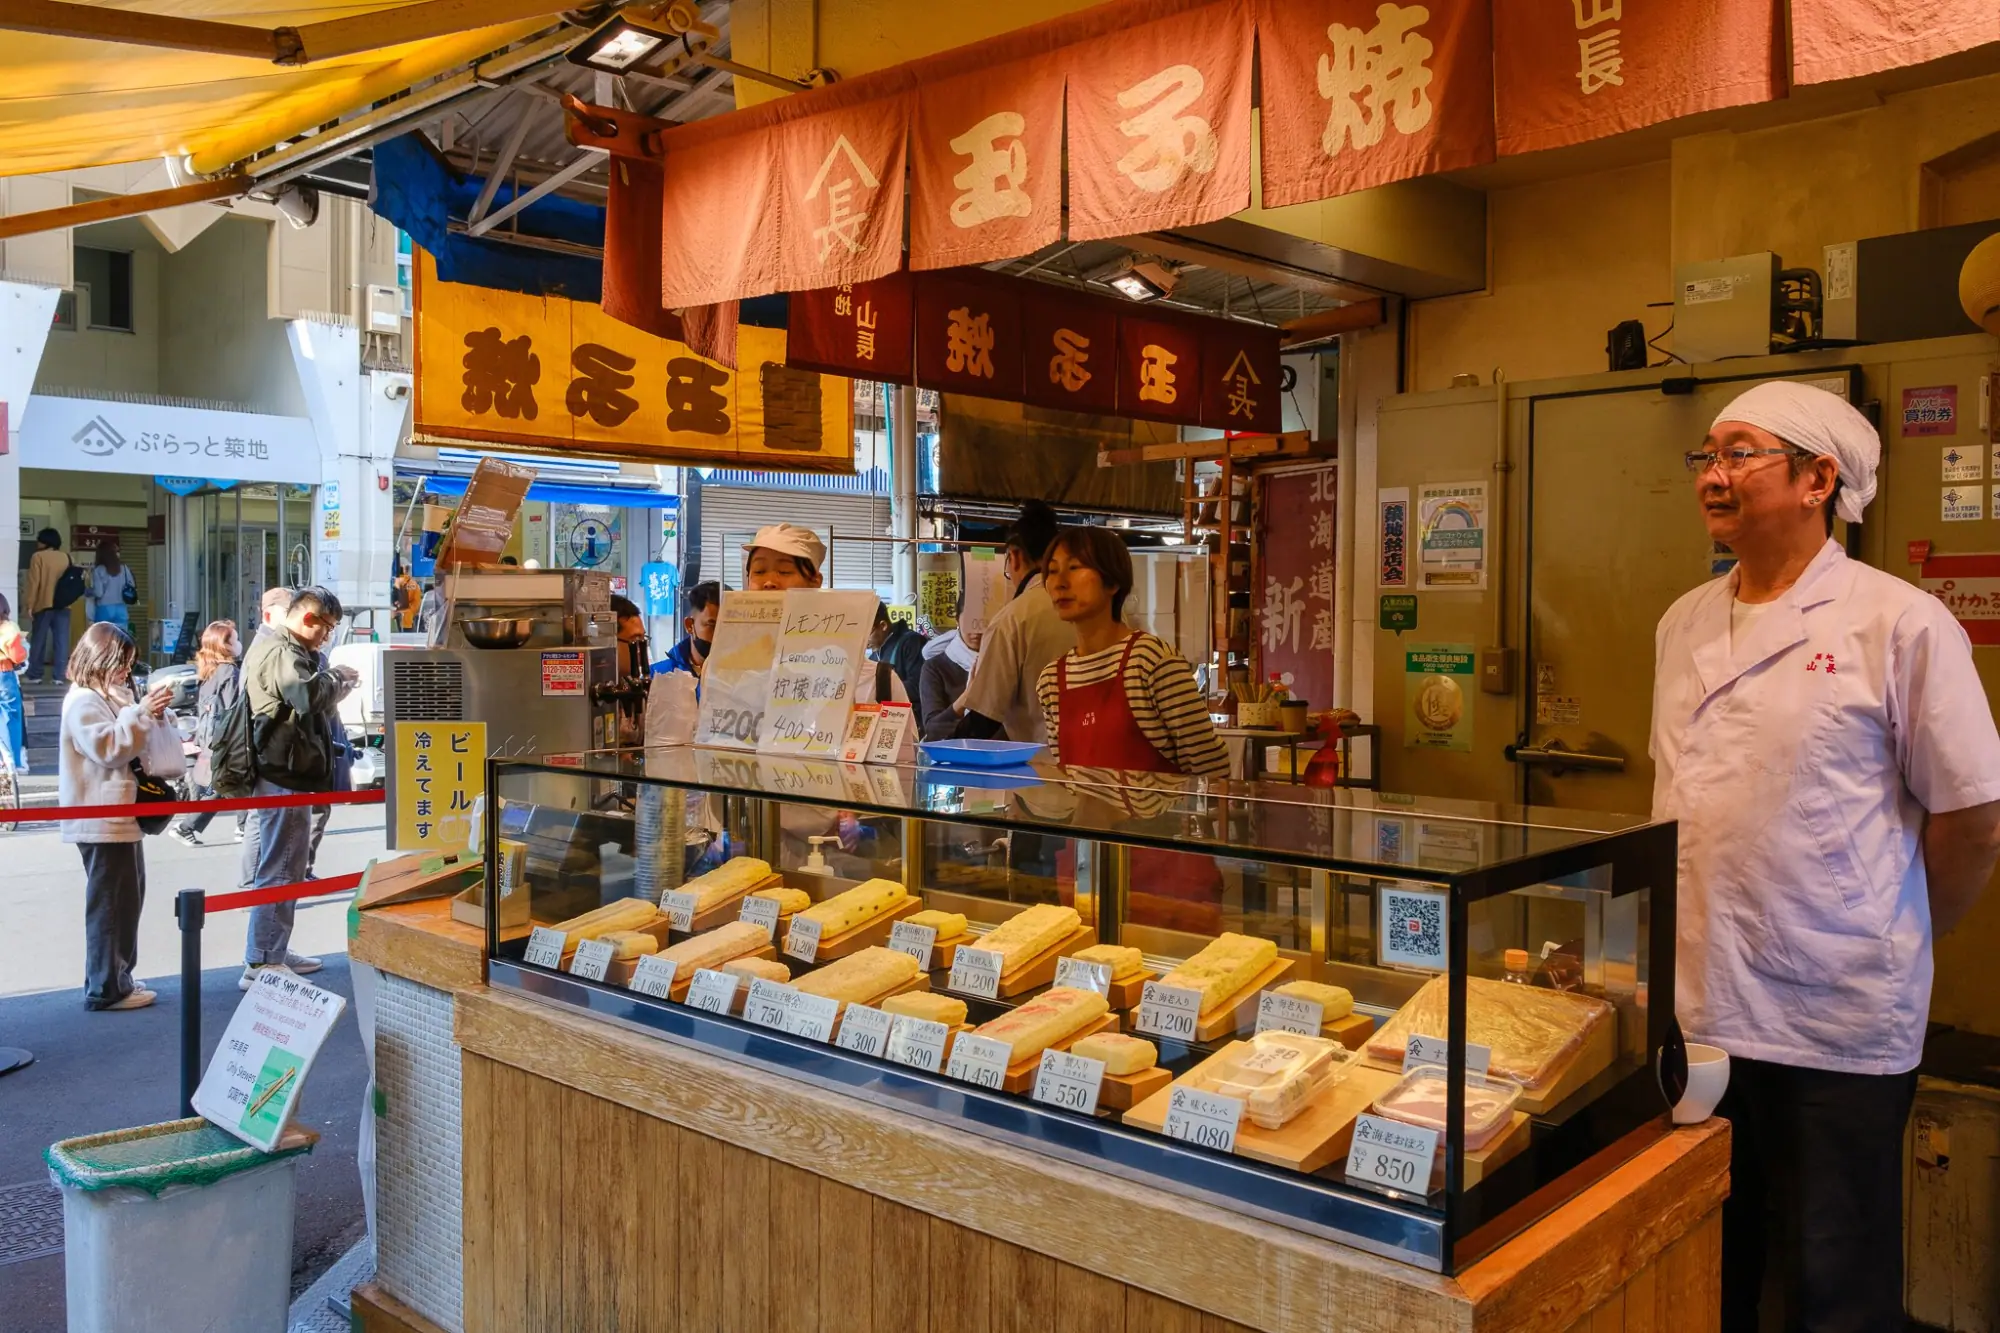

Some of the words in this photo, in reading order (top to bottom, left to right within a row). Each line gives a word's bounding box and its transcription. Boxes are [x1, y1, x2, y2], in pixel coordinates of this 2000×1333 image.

[1904, 407, 1952, 423] 買物券
[134, 431, 269, 460] ぷらっと築地
[1309, 471, 1336, 650] 北海道産
[785, 613, 858, 635] レモンサワー
[890, 610, 913, 621] eep
[1261, 576, 1306, 653] 新
[780, 646, 815, 665] Lemon
[822, 648, 847, 665] Sour
[543, 665, 584, 674] 0120-70-2525
[773, 715, 804, 741] 400
[803, 726, 833, 750] yen
[450, 731, 471, 811] ビール
[414, 731, 433, 839] 冷えてます
[1159, 991, 1190, 1006] 海老入り
[760, 1005, 783, 1026] 750
[1142, 1011, 1193, 1035] ¥1,200
[799, 1020, 822, 1039] 750
[852, 1032, 877, 1054] 300
[1055, 1083, 1087, 1108] 550
[1190, 1099, 1229, 1116] 味くらべ
[1371, 1128, 1425, 1151] 海老おぼろ
[1374, 1154, 1415, 1184] 850
